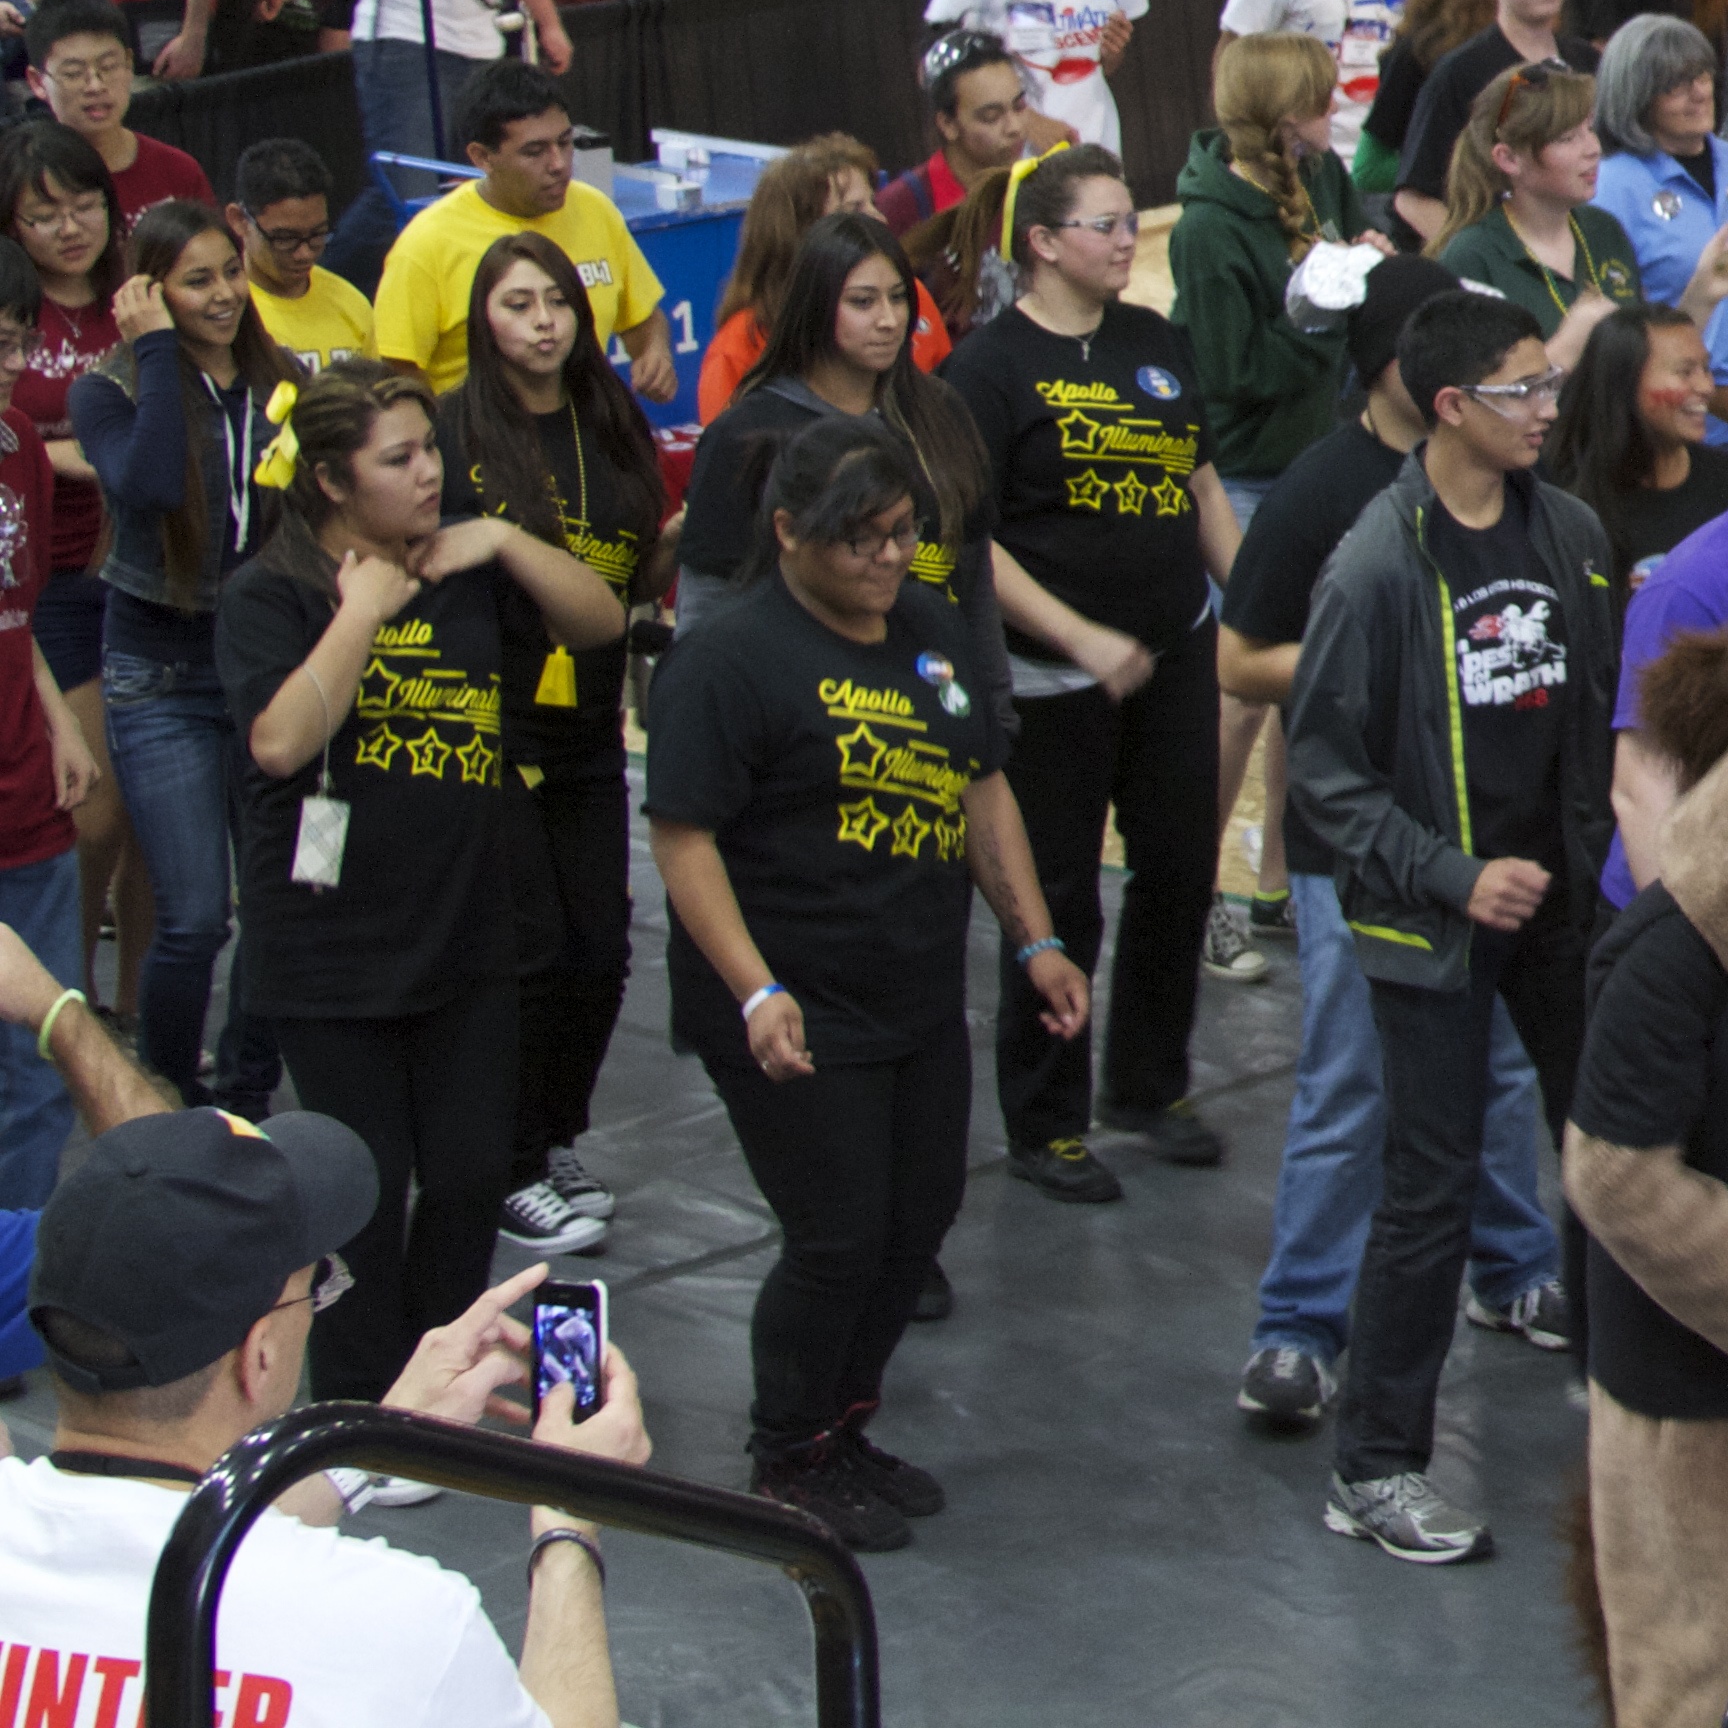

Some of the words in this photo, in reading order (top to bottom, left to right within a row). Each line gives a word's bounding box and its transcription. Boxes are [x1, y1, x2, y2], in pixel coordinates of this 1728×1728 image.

[671, 299, 700, 354] 1
[1035, 378, 1120, 405] Apollo
[373, 618, 433, 647] ollo
[818, 677, 914, 717] Apollo
